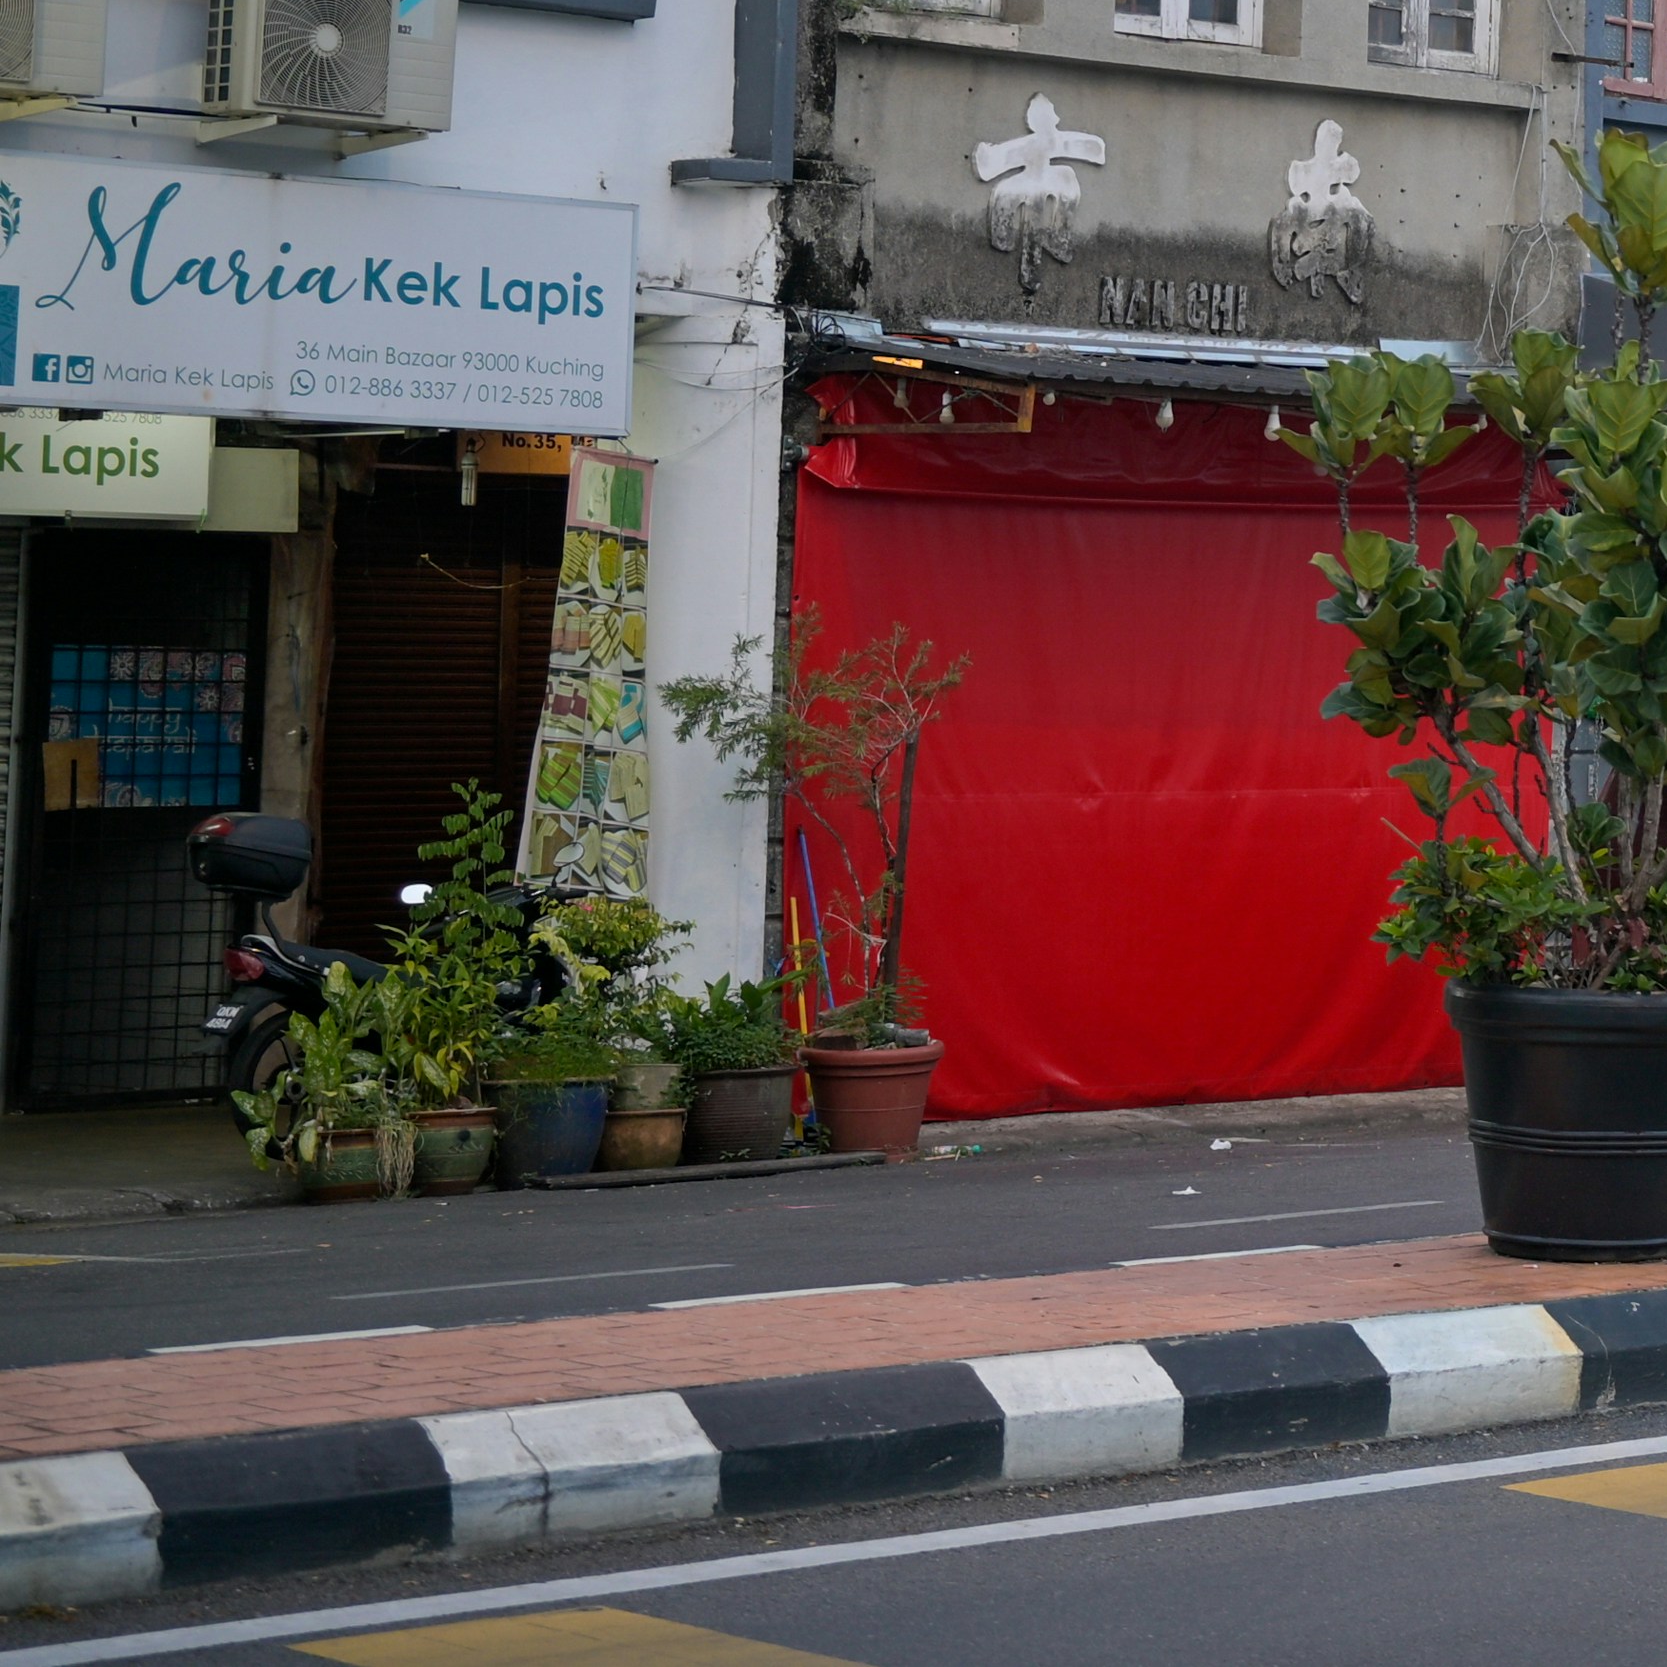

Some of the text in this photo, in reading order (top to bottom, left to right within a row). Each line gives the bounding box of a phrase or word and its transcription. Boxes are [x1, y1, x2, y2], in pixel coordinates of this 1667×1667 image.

[35, 181, 604, 325] Maria Kek Lapis
[1186, 281, 1249, 333] CHI
[103, 363, 274, 393] Maria Kek Lapis
[296, 340, 604, 382] 36 Main Bazaar 93000 Kuching
[325, 375, 403, 398] 012-886
[410, 381, 456, 401] 3337
[477, 384, 554, 407] 012-525
[560, 389, 603, 409] 7808
[42, 434, 160, 486] Lapis
